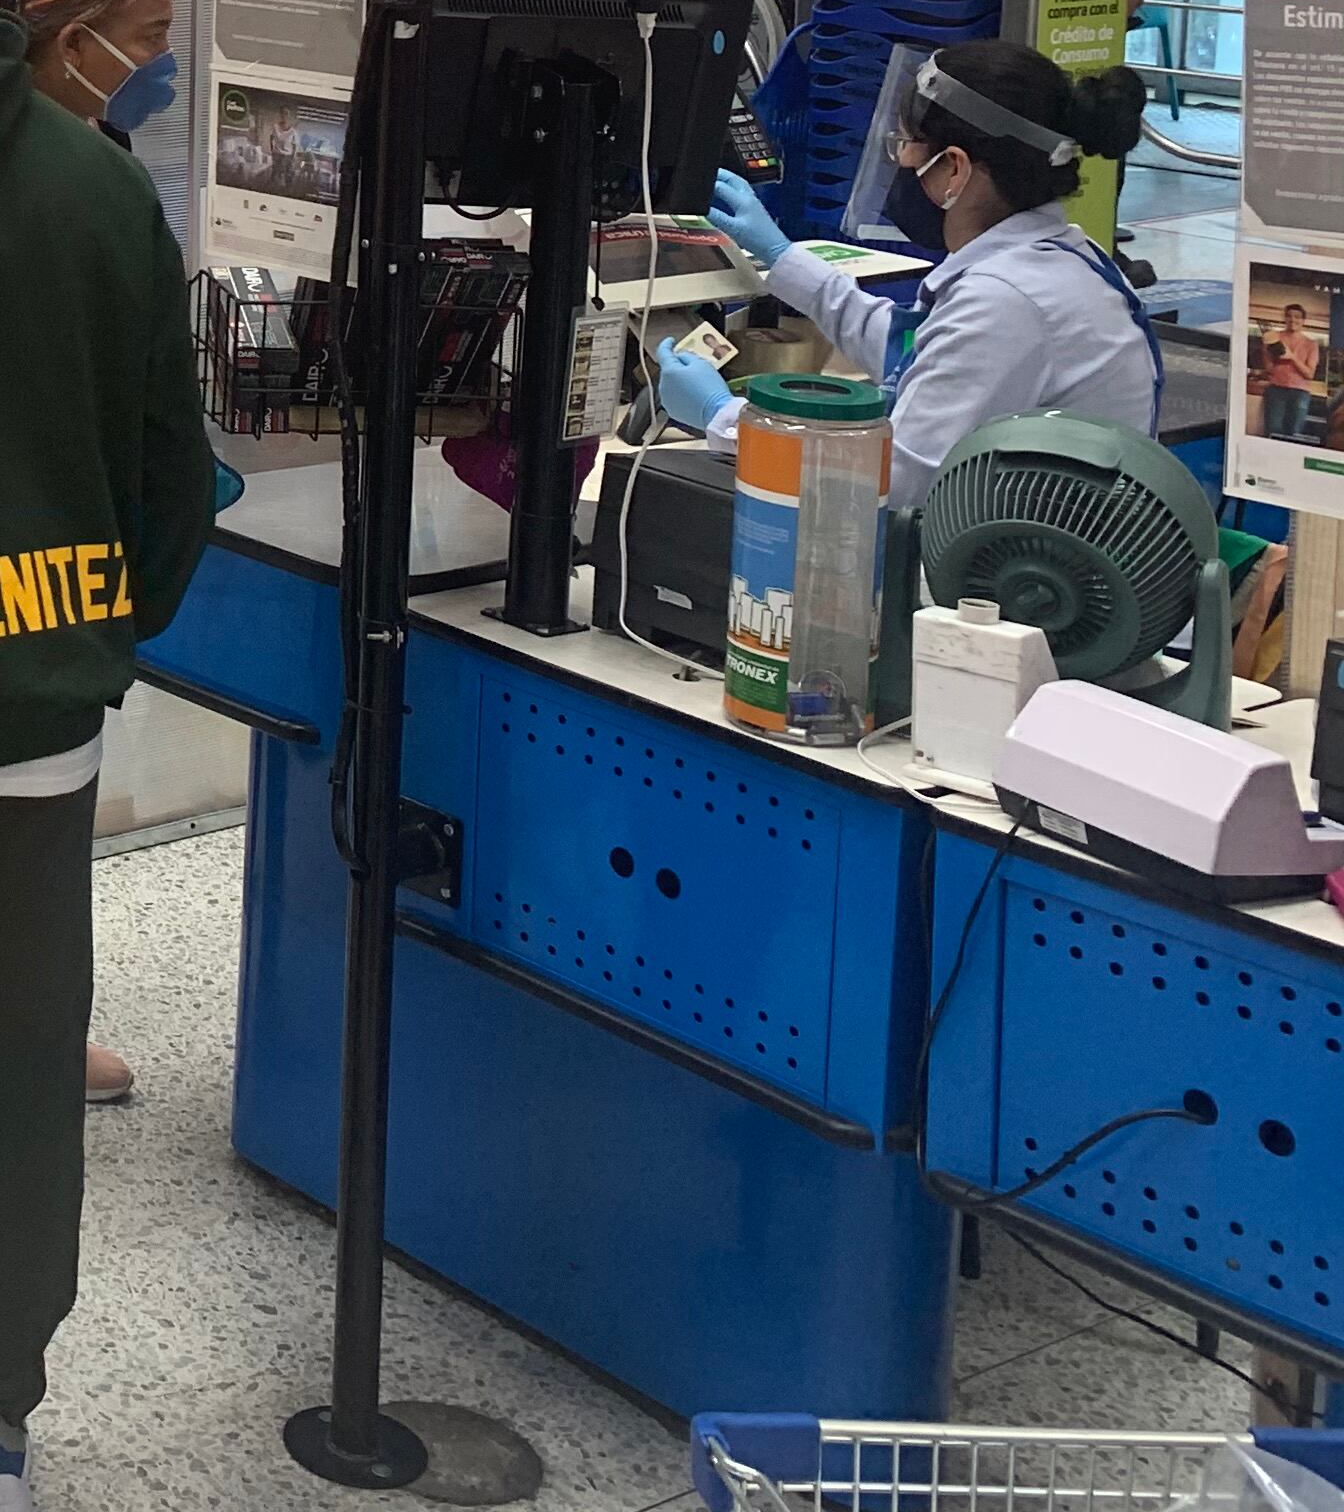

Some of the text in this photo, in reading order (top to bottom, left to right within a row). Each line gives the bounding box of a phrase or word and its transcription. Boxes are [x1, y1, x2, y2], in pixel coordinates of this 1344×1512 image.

[1047, 0, 1119, 21] compra con el
[1050, 24, 1114, 45] Crédito de
[1052, 46, 1110, 64] Consumo
[726, 654, 778, 685] TRONEX
